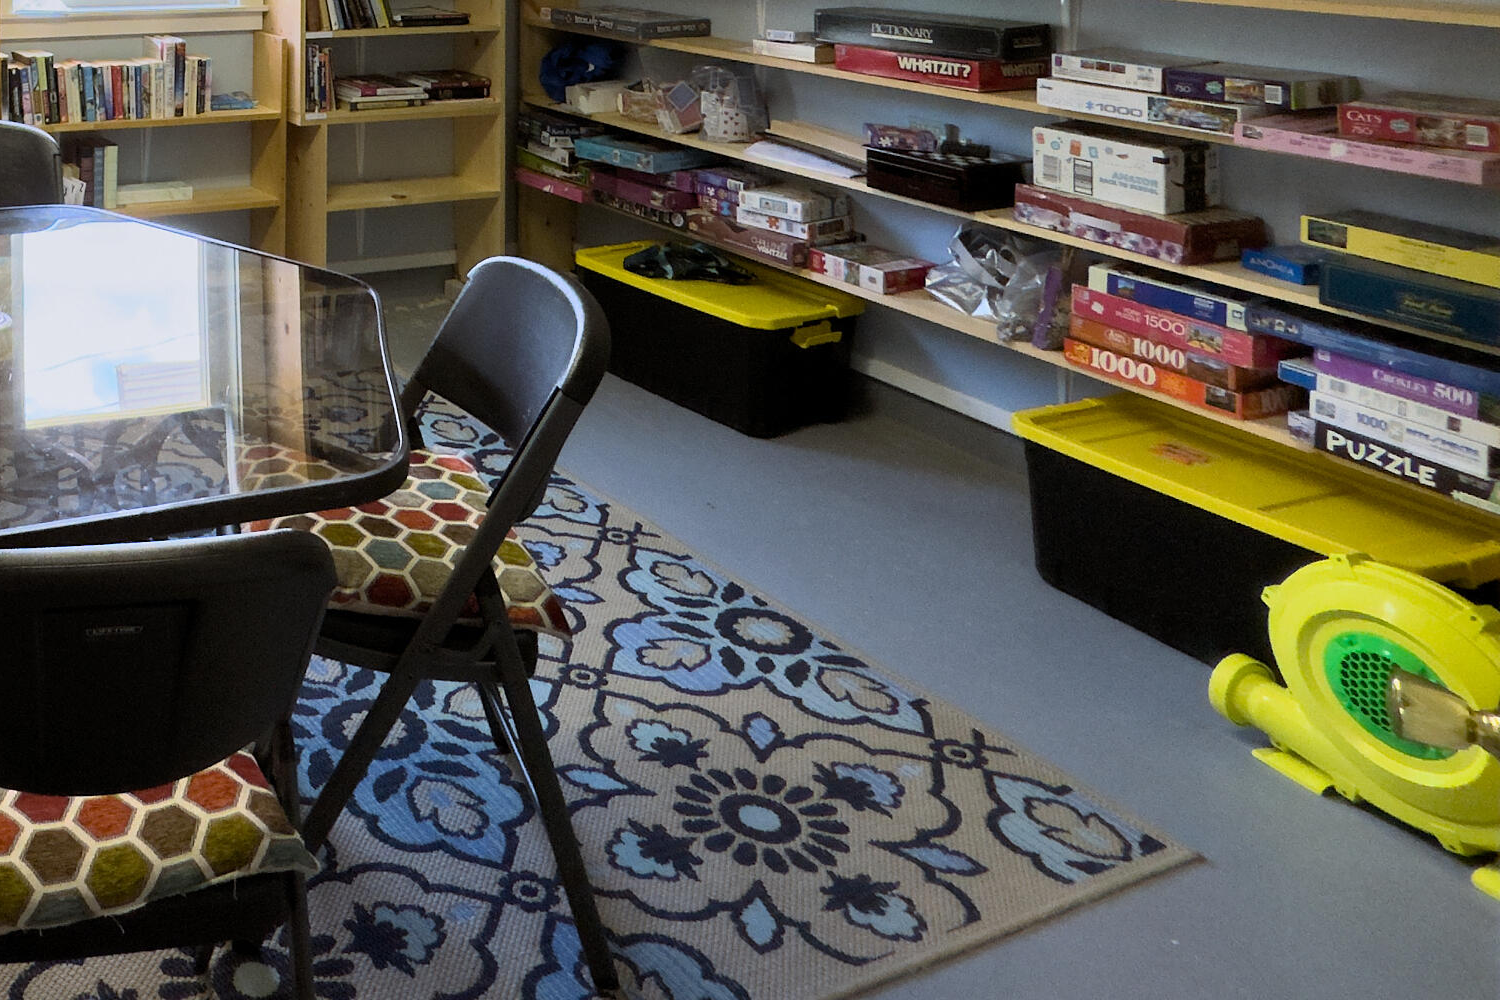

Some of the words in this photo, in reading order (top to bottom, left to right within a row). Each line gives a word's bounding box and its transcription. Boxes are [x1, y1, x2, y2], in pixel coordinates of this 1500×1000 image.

[871, 22, 933, 40] PICTIONARY
[896, 56, 972, 78] WHATZIT?
[1098, 101, 1143, 118] 1000
[1144, 314, 1185, 336] 1500
[1132, 337, 1185, 369] 1000
[1090, 347, 1156, 385] 1000
[1432, 382, 1473, 406] 500
[1326, 430, 1437, 488] PUZZLE
